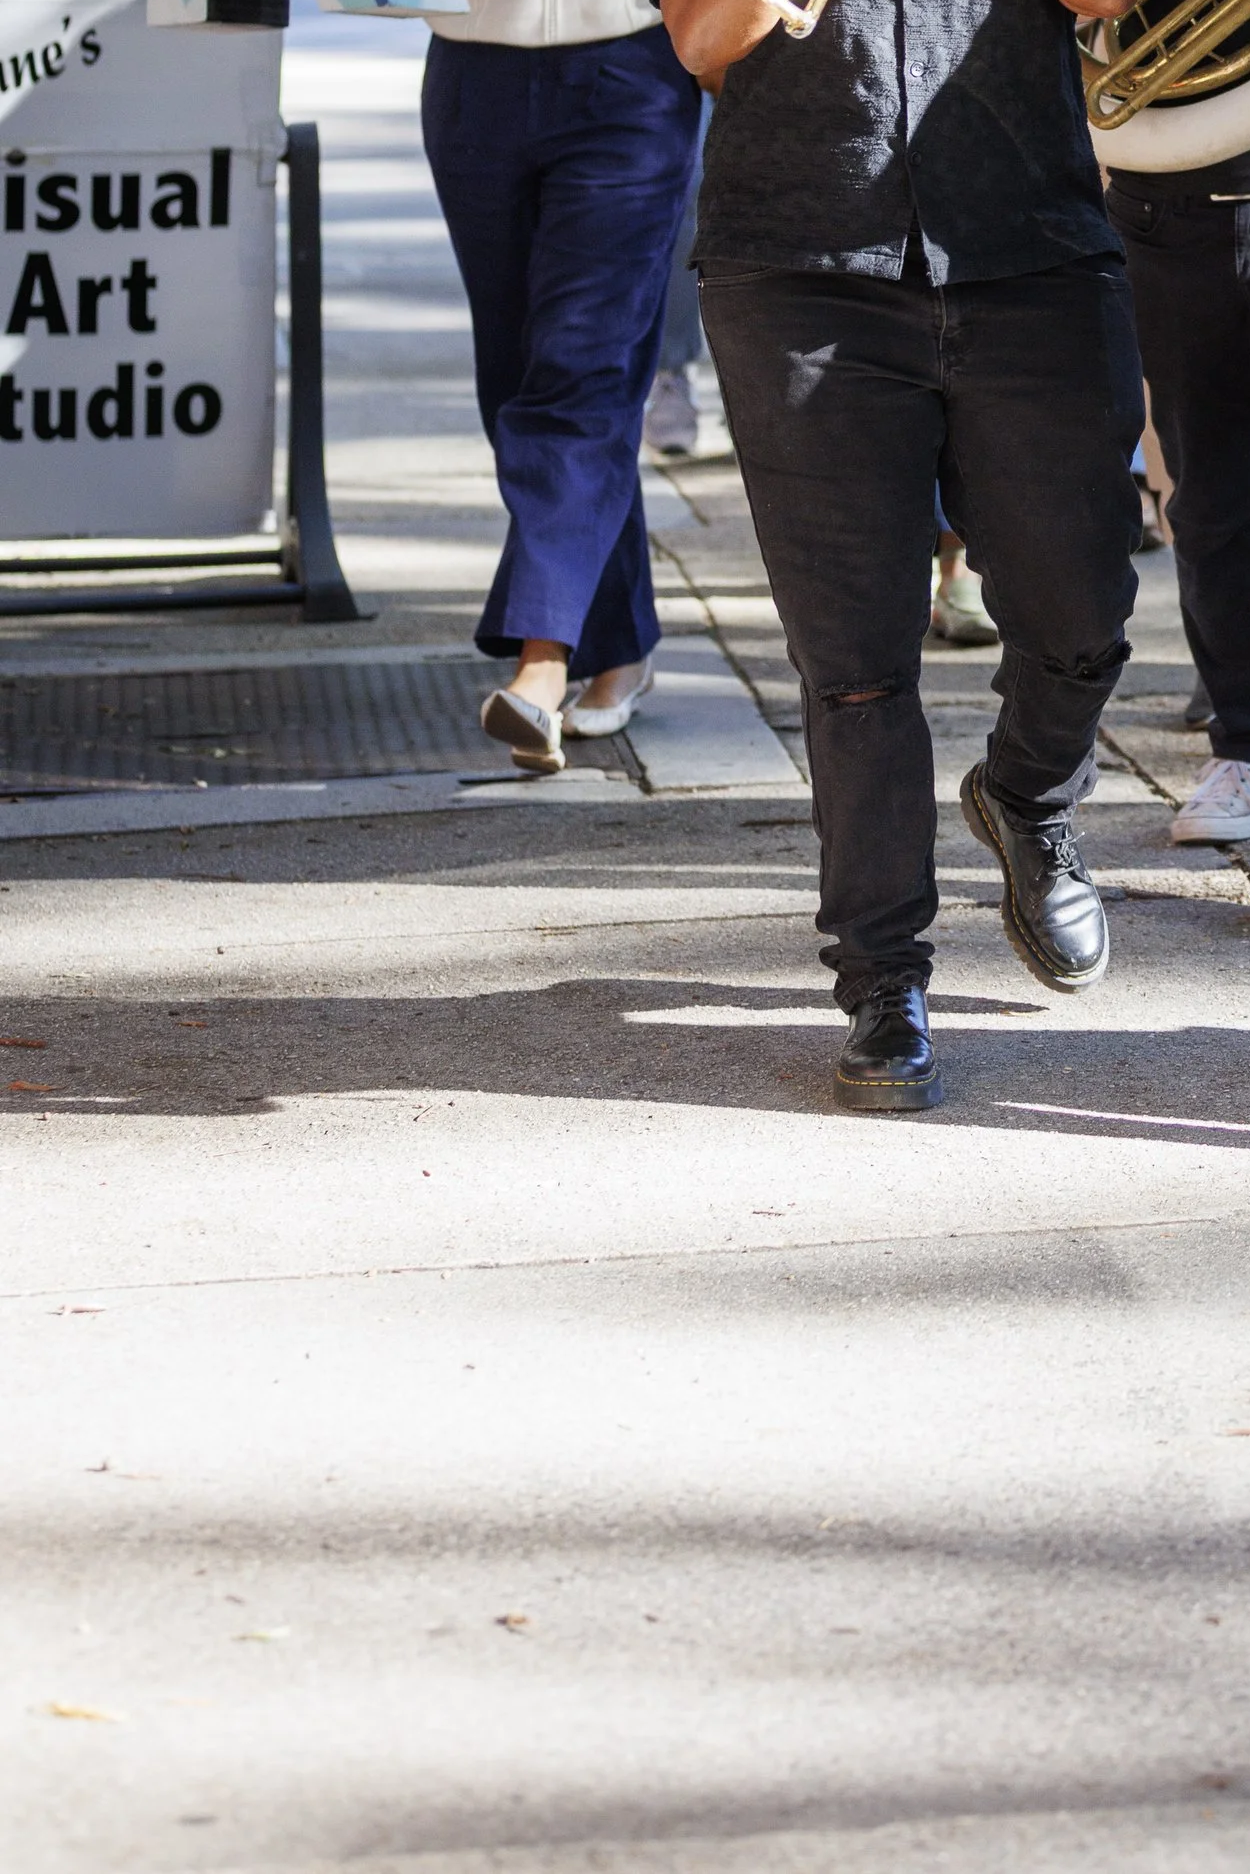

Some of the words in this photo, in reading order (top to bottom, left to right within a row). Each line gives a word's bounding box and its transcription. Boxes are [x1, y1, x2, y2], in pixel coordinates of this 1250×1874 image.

[4, 147, 232, 233] isual
[8, 252, 157, 335] Art
[0, 361, 223, 442] tudio
